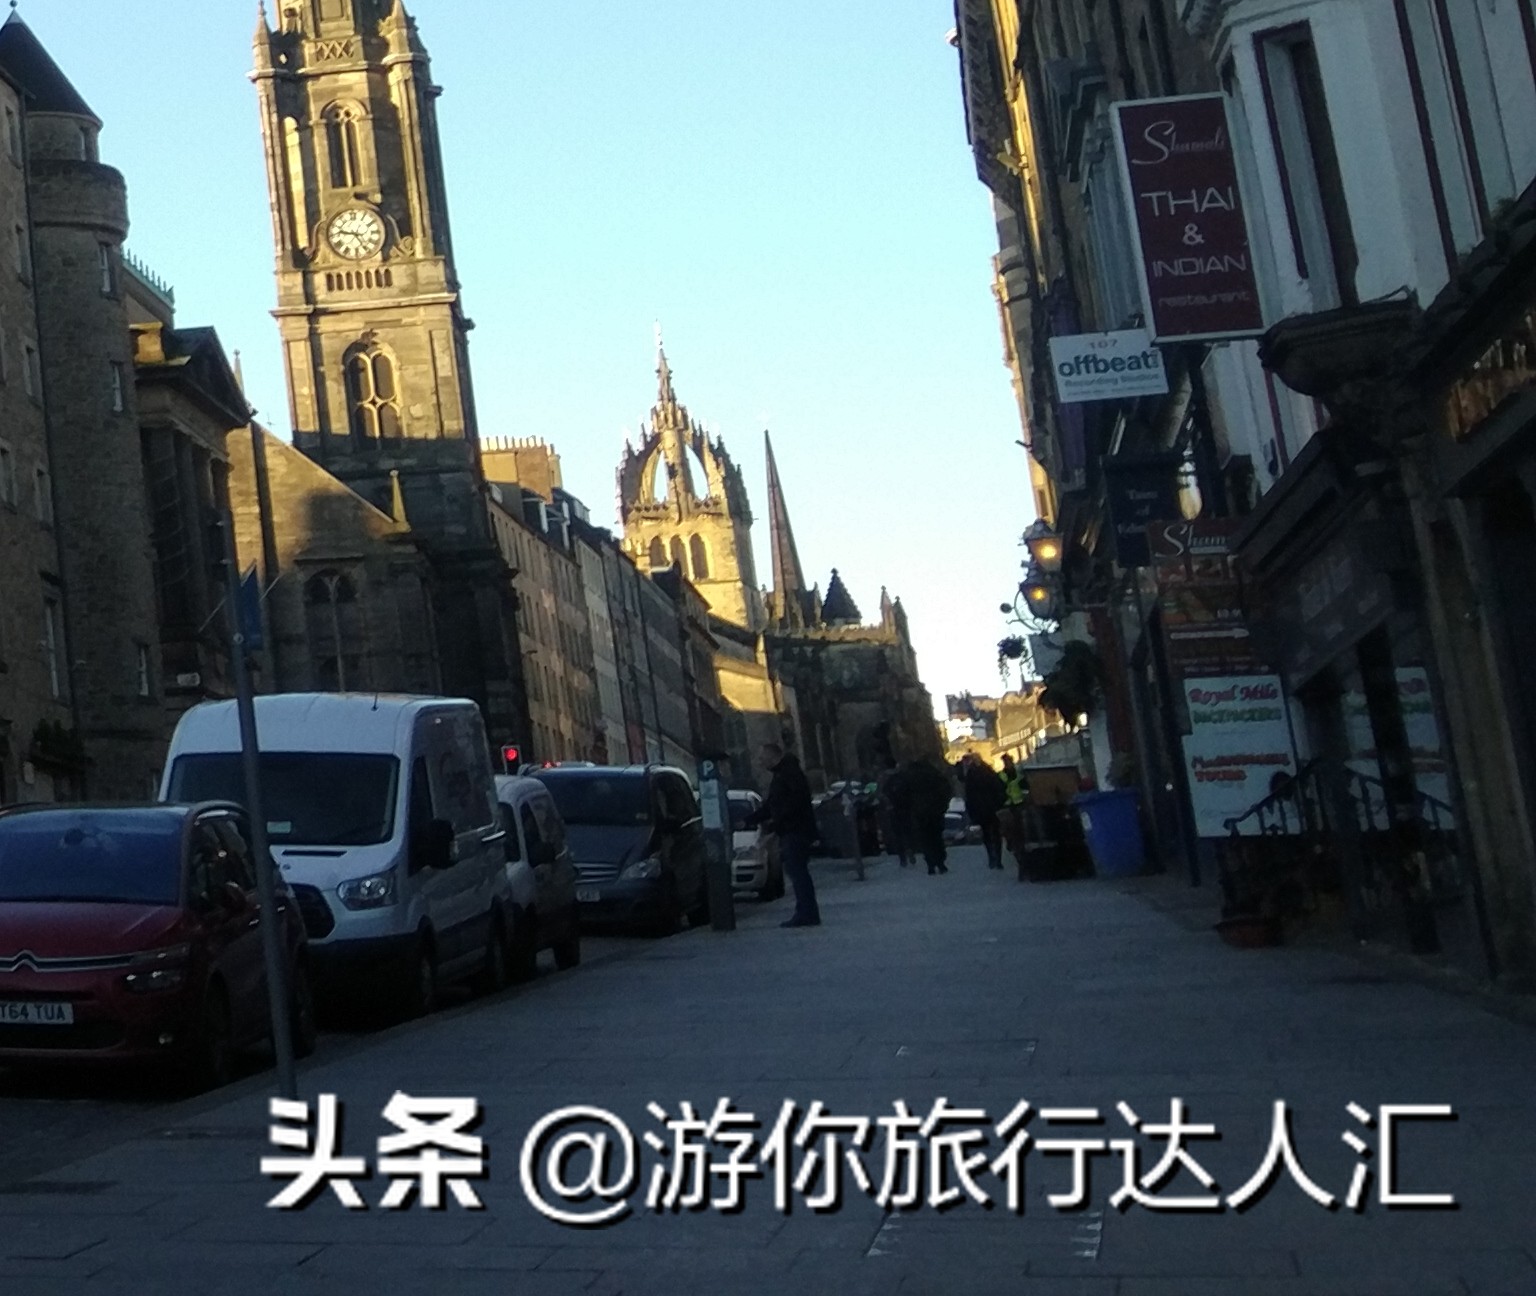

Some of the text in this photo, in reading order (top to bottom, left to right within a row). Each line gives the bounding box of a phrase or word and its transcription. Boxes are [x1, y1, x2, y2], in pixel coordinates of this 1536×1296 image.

[1140, 186, 1236, 217] THAI
[1182, 222, 1205, 245] &
[1152, 254, 1247, 278] INDIAN
[1057, 350, 1152, 378] offbeat
[1154, 523, 1230, 557] Sham
[34, 1004, 66, 1021] TUA
